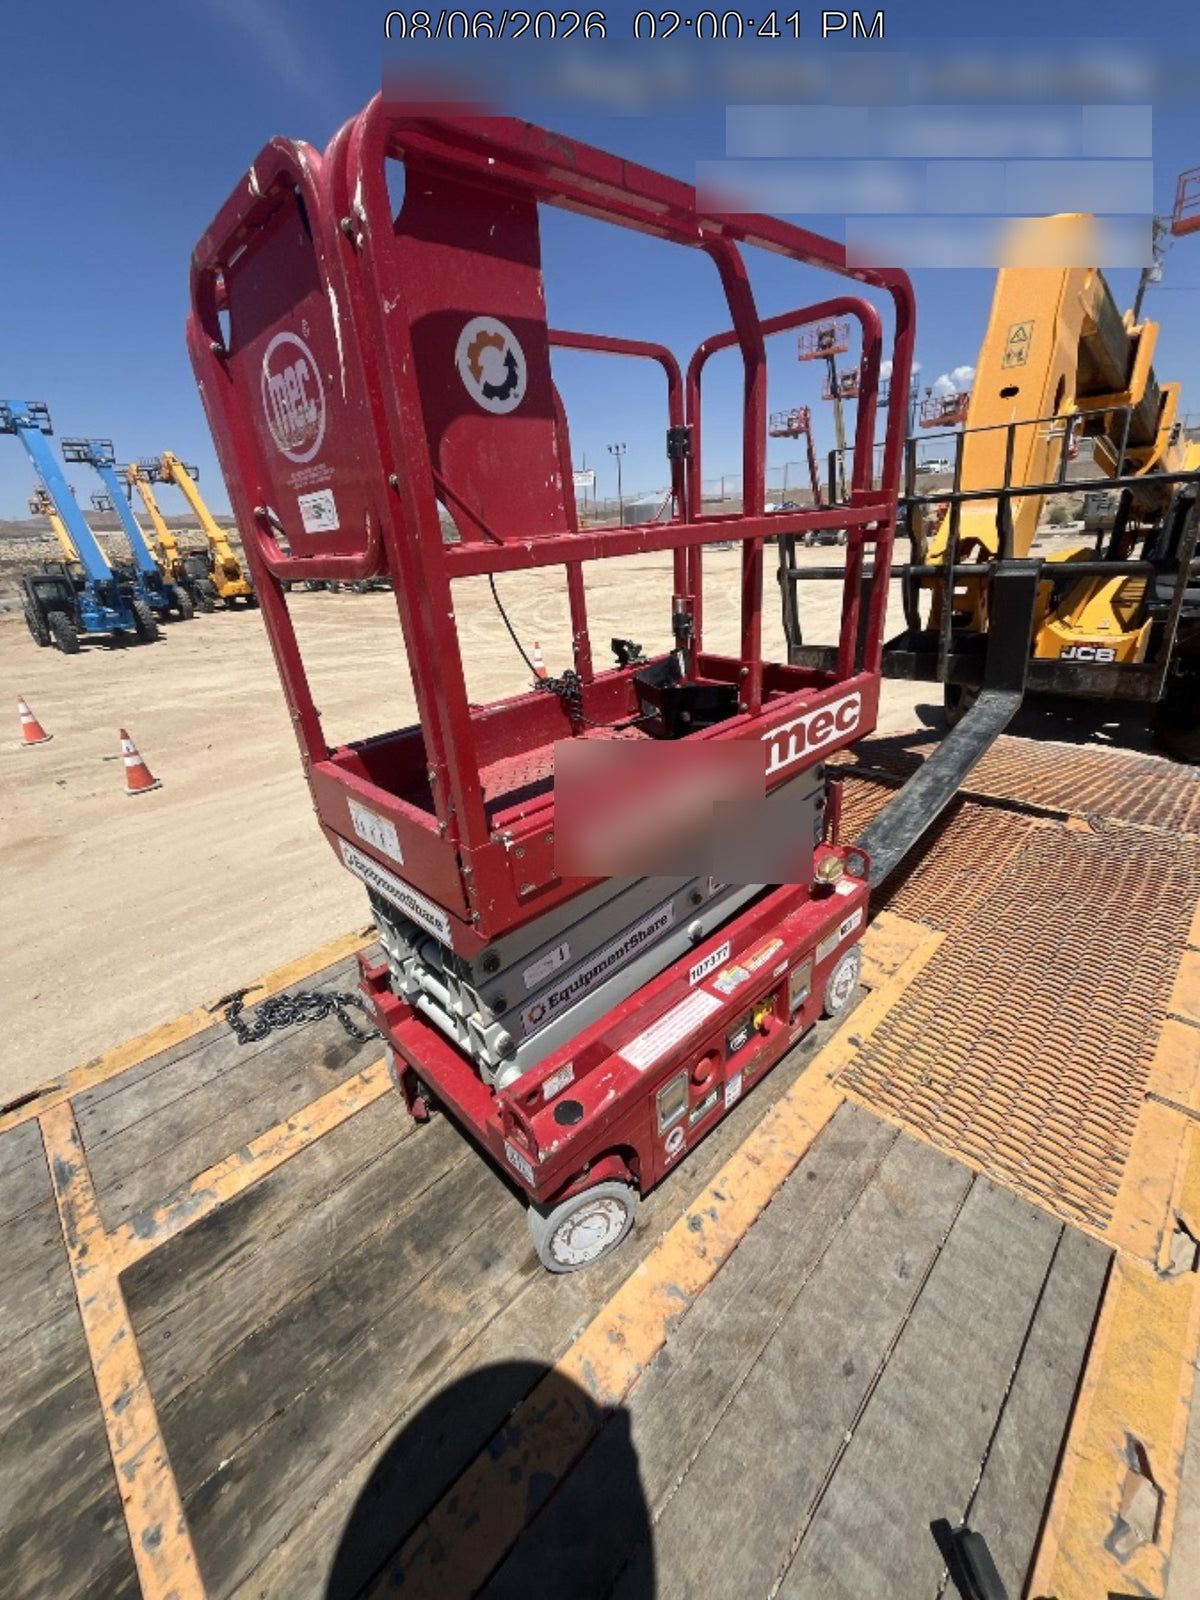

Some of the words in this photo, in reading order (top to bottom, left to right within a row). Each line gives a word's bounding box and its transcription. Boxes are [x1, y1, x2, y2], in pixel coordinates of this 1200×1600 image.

[1061, 646, 1116, 662] JCB
[762, 691, 861, 776] mec
[549, 914, 668, 1010] EquipmentShare
